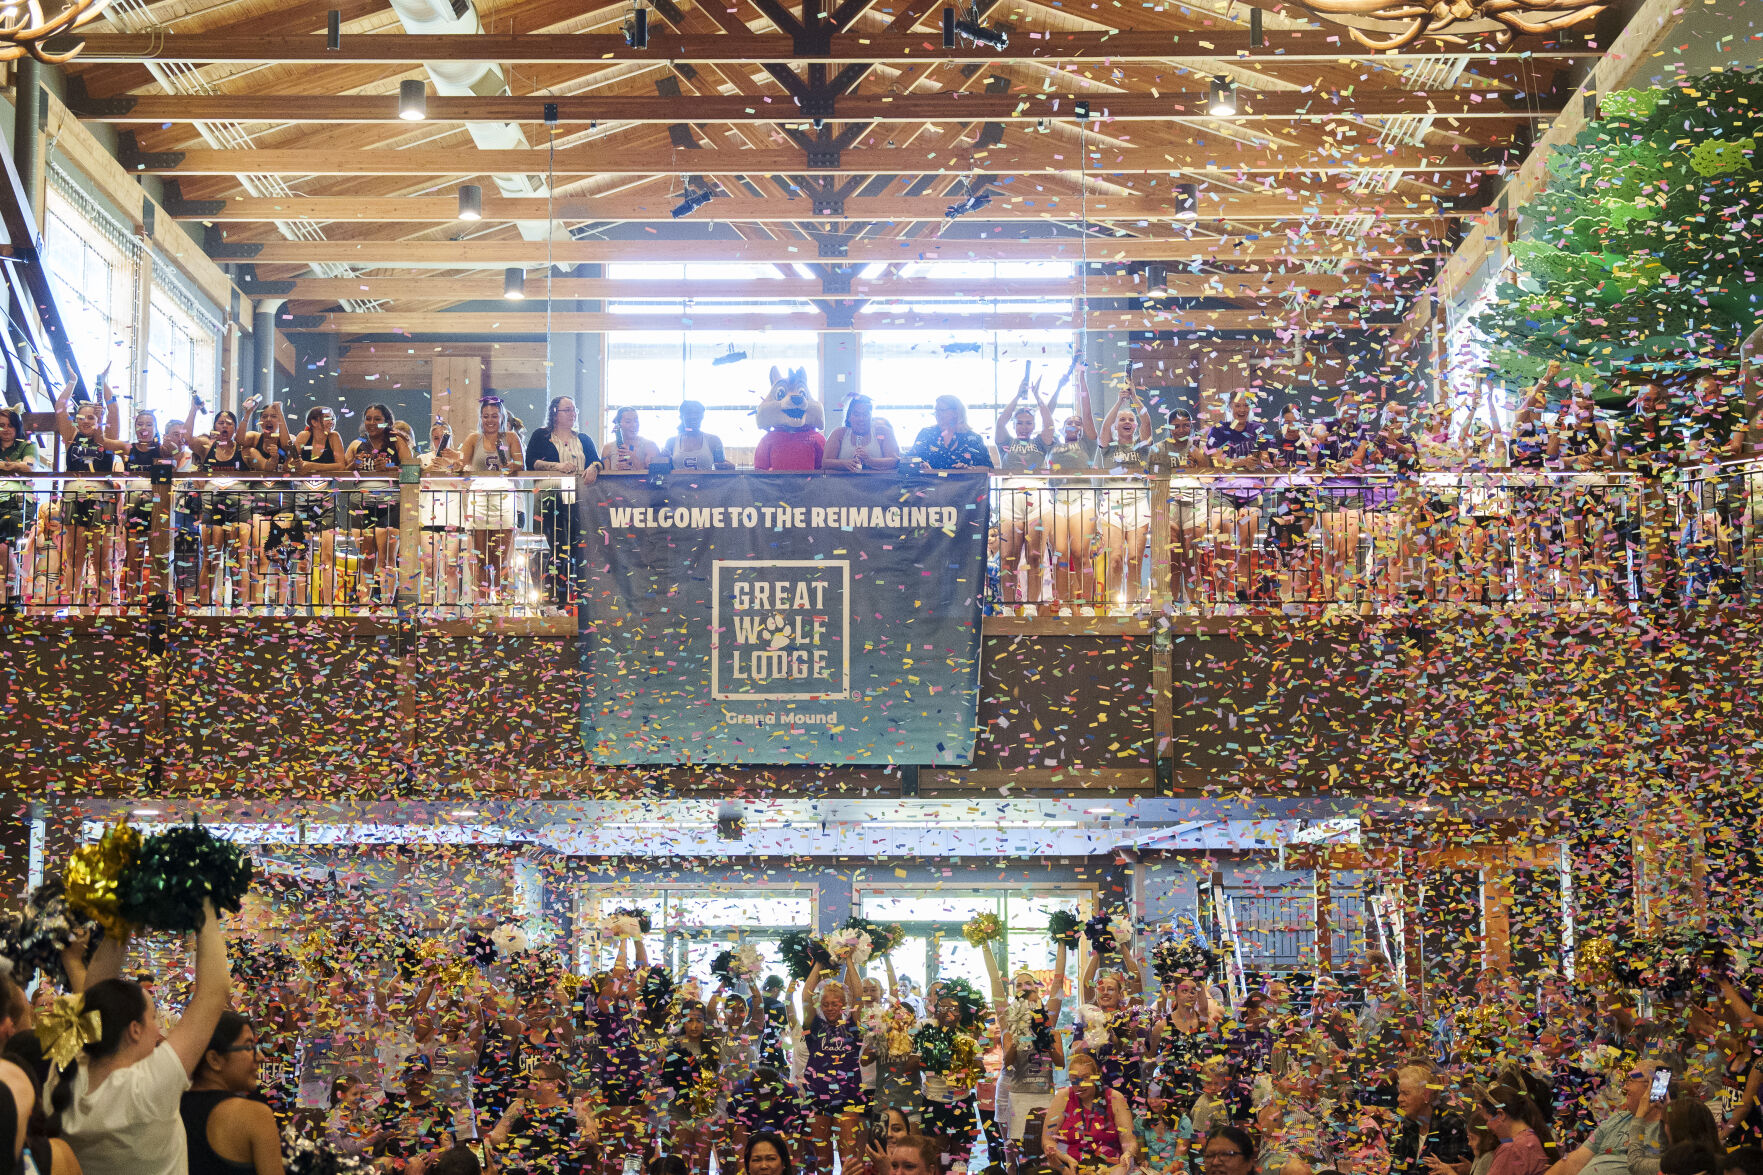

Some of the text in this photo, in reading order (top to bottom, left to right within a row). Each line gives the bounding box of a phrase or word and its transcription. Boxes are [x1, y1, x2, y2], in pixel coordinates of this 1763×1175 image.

[610, 506, 958, 528] WELCOME TO THE REIMAGINED
[733, 581, 828, 610] GREAT
[733, 650, 828, 679] LODGE
[726, 711, 838, 725] Grand Mound
